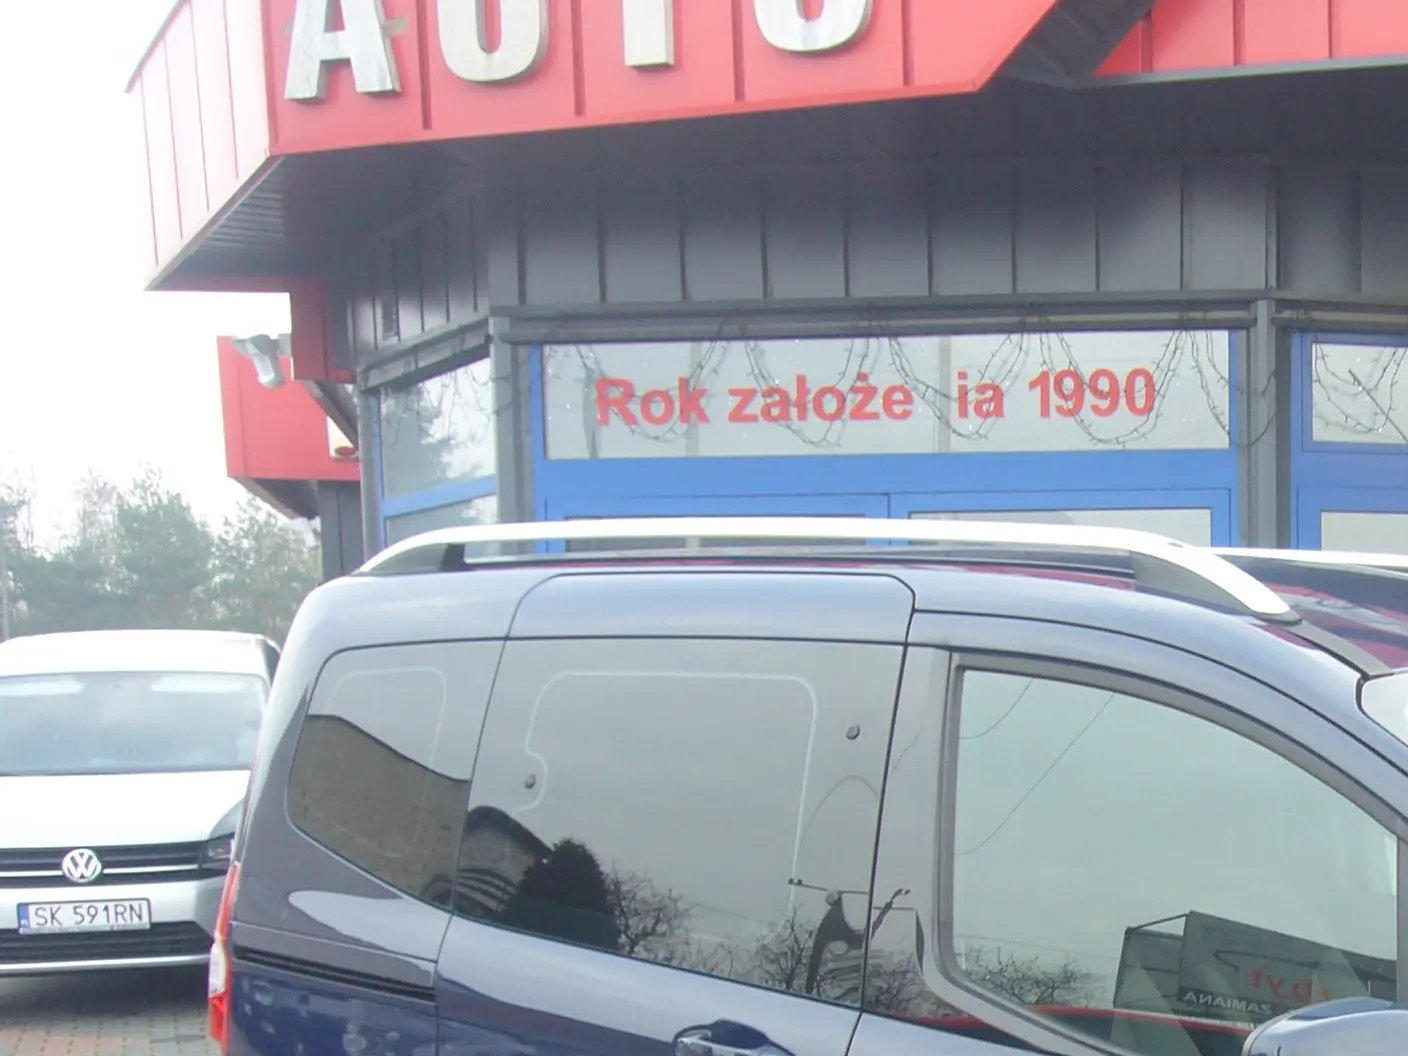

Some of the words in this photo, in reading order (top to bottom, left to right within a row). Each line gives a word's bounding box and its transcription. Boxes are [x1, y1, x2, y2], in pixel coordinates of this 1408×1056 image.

[596, 377, 710, 425] Rok
[1028, 367, 1157, 418] 1990
[34, 905, 63, 927] SK
[72, 903, 144, 926] 591RN
